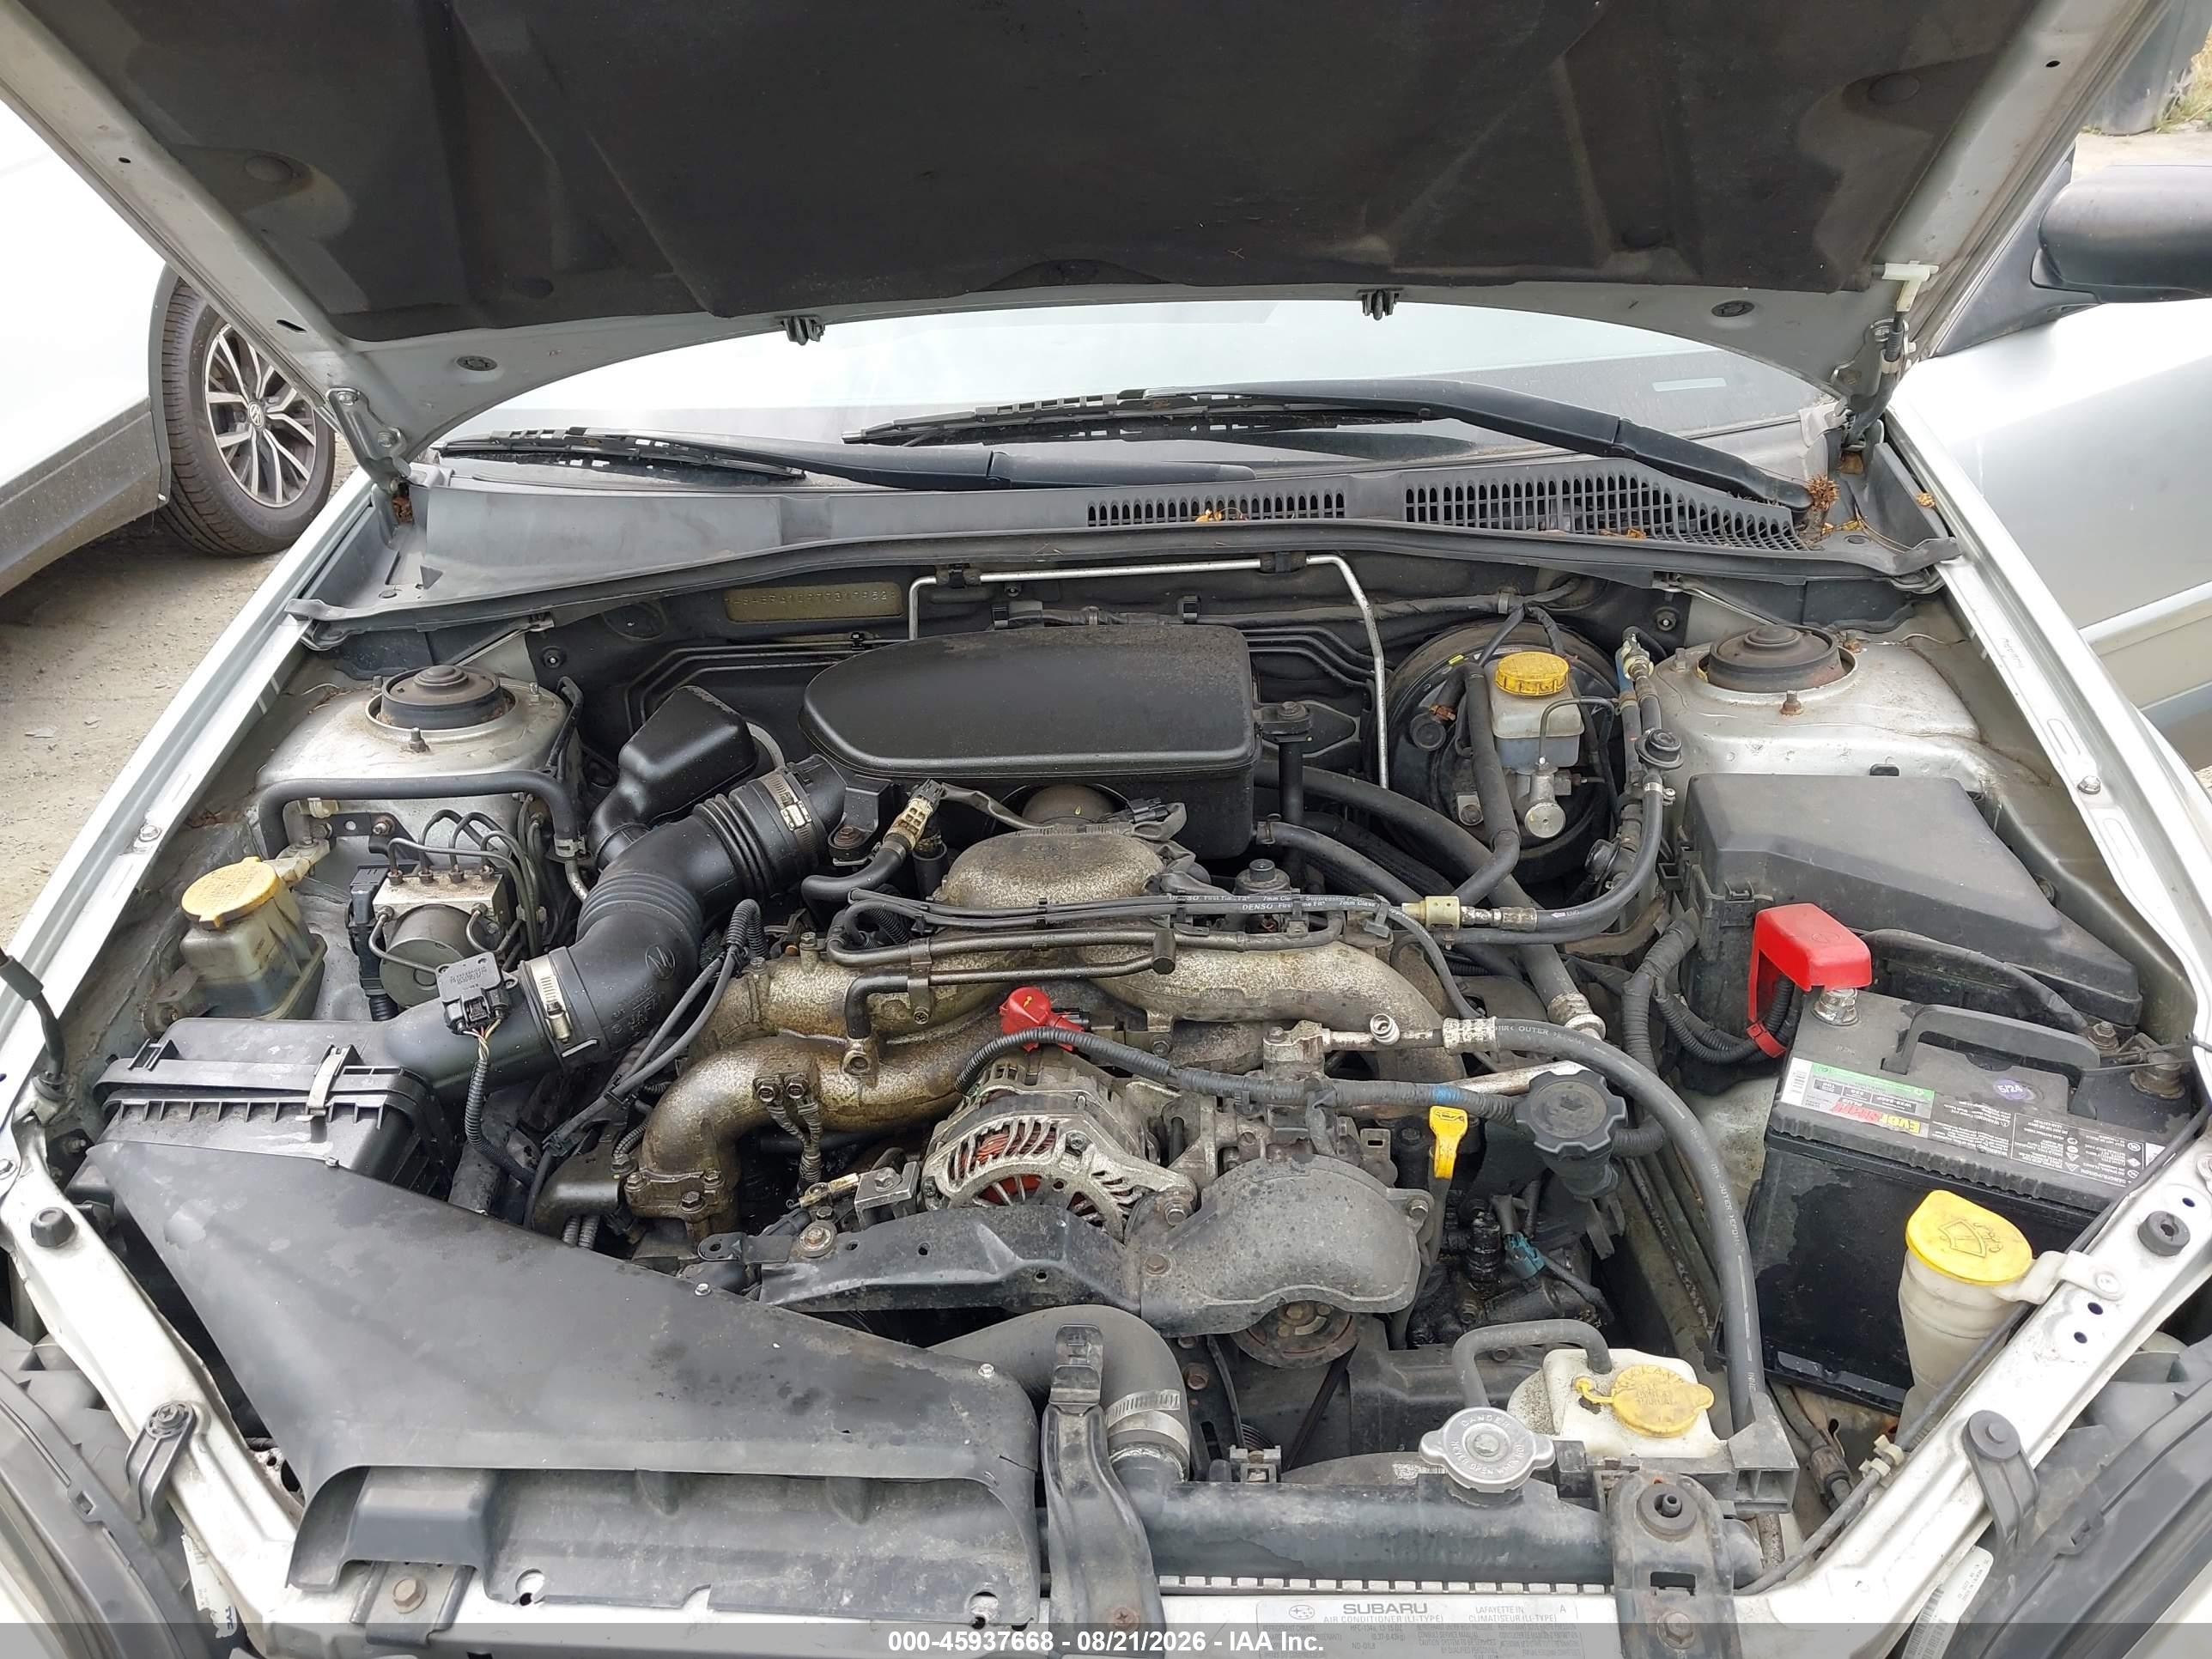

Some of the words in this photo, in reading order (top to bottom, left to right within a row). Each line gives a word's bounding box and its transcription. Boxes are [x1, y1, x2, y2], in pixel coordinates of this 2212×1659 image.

[1518, 1025, 1549, 1036] OUTER
[1997, 1084, 2023, 1093] 5/24
[1462, 1414, 1512, 1429] DANGER
[1343, 1603, 1428, 1614] SUBARU
[1559, 1605, 1567, 1613] A
[225, 1605, 234, 1630] TYC
